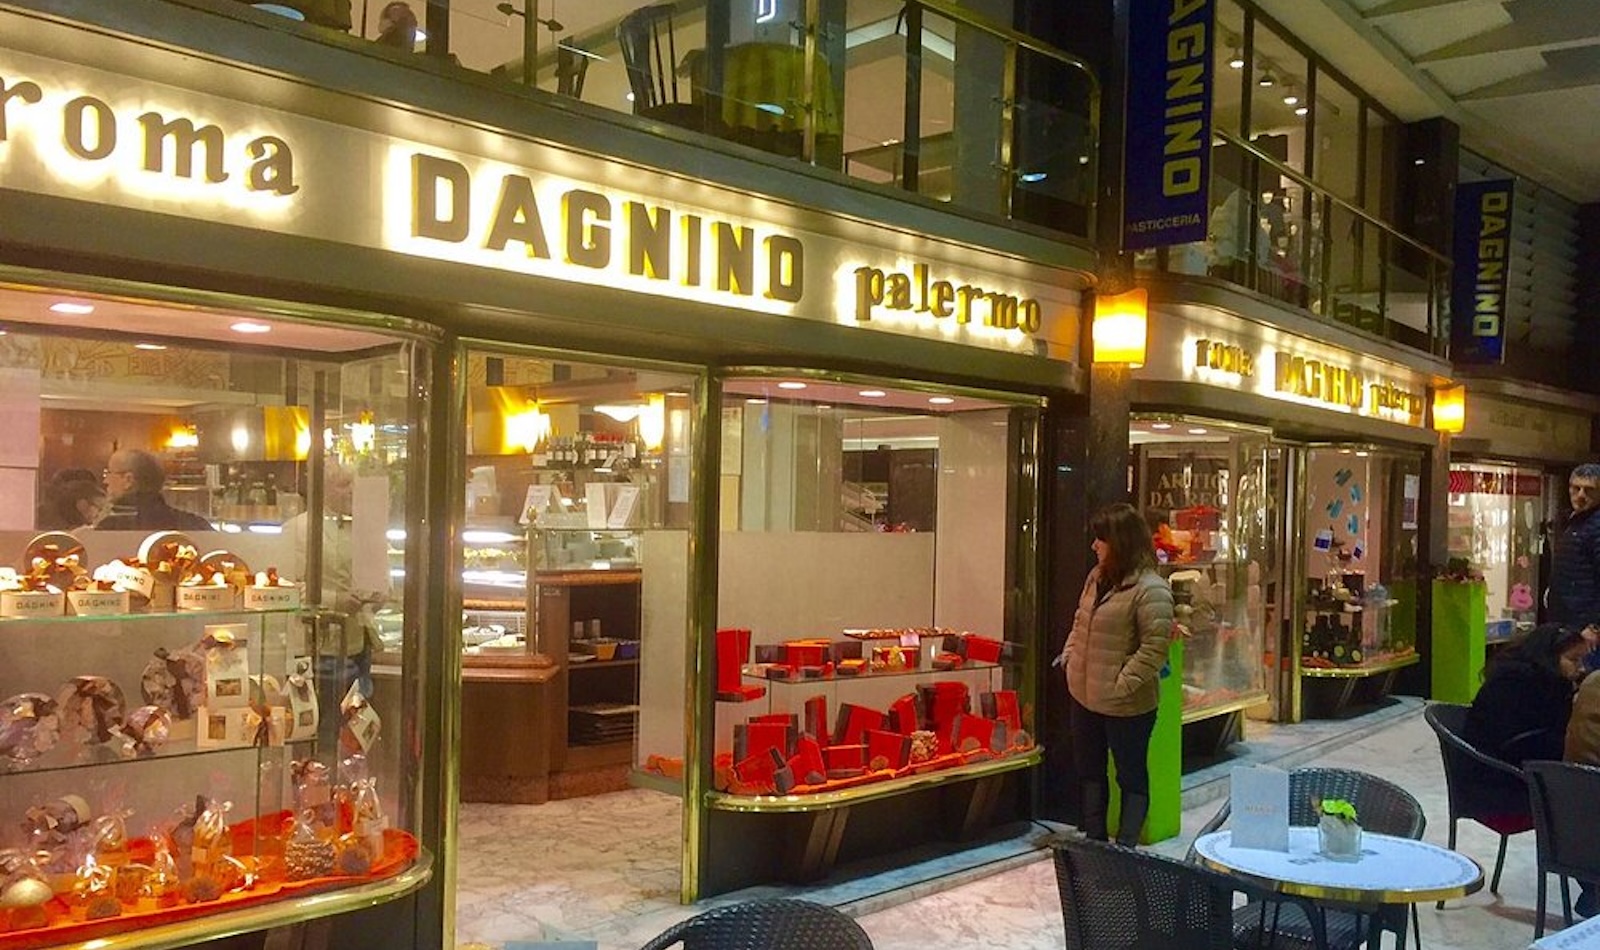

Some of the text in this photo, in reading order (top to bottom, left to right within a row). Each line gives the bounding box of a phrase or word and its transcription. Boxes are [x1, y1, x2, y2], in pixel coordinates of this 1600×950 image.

[0, 77, 1042, 334] roma DAGNINO palermo
[1127, 212, 1201, 234] ASTICCERIA
[1472, 191, 1509, 337] DAGNINO
